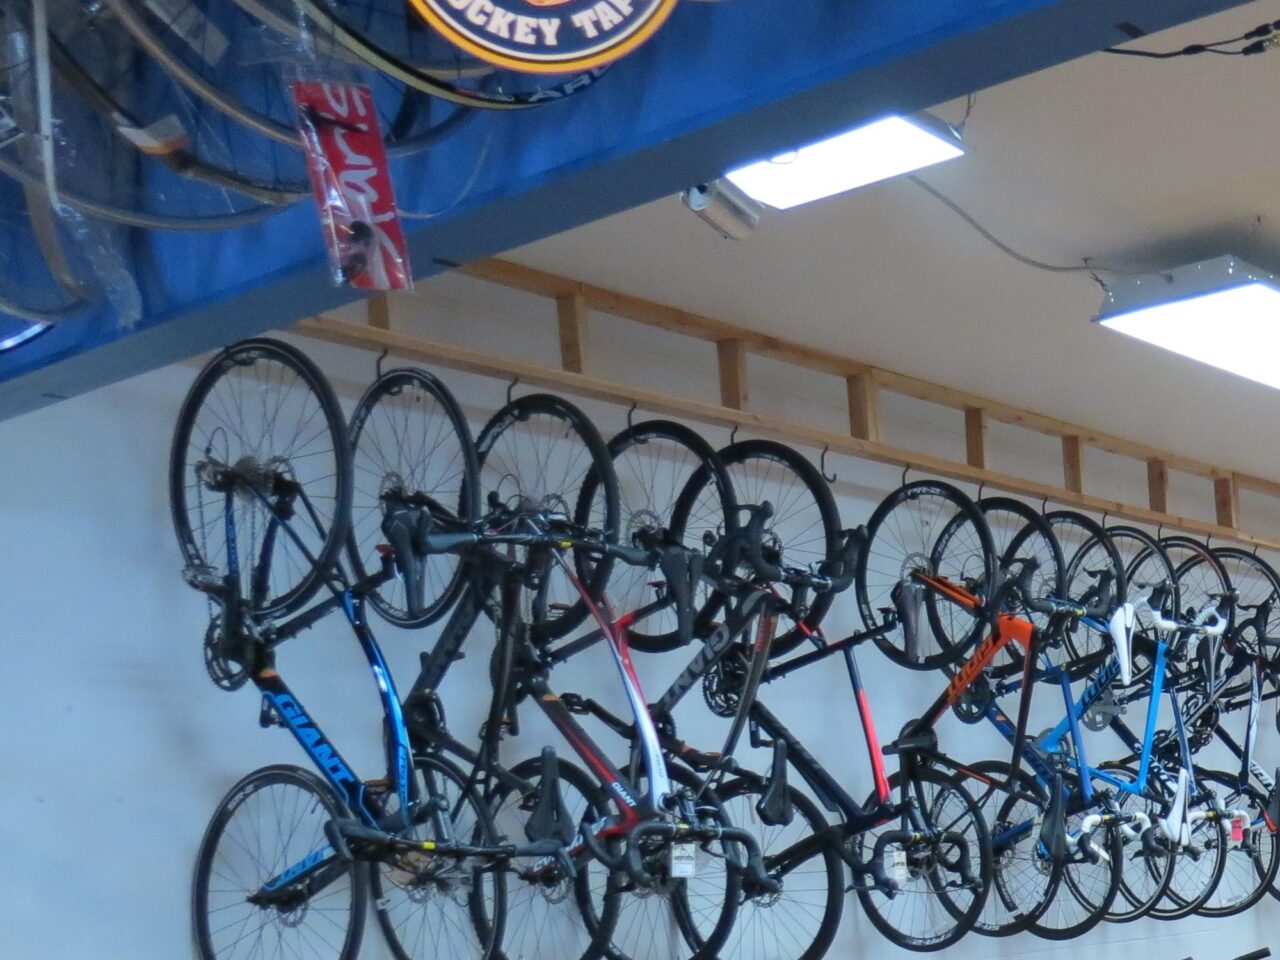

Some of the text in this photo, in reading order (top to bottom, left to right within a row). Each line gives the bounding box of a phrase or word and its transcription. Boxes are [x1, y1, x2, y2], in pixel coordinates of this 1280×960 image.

[663, 621, 730, 711] GIANT
[273, 693, 356, 784] GIANT
[611, 781, 637, 808] GIANT
